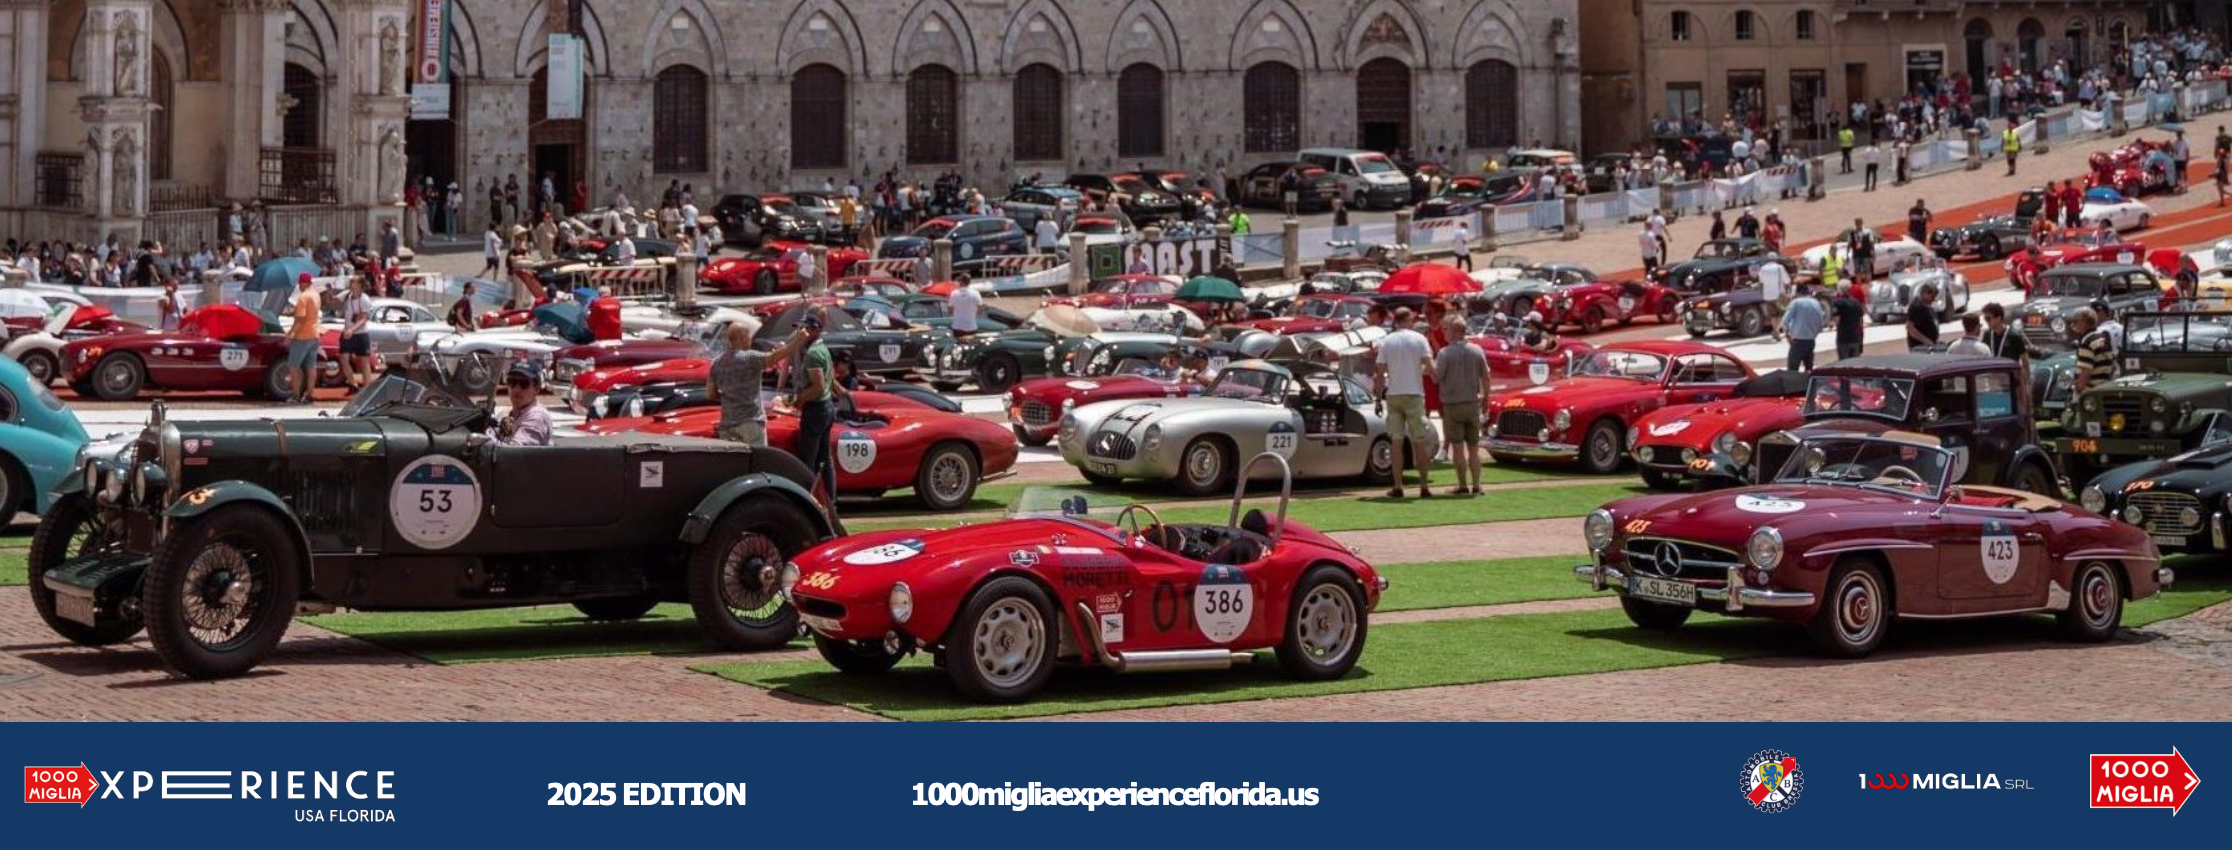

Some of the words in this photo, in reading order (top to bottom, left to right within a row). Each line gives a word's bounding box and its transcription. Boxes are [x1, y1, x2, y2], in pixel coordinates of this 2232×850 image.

[845, 443, 869, 458] 198
[1272, 435, 1291, 448] 221
[419, 489, 453, 513] 53
[1987, 541, 2013, 561] 423
[802, 571, 841, 590] 386
[1205, 589, 1244, 614] 386
